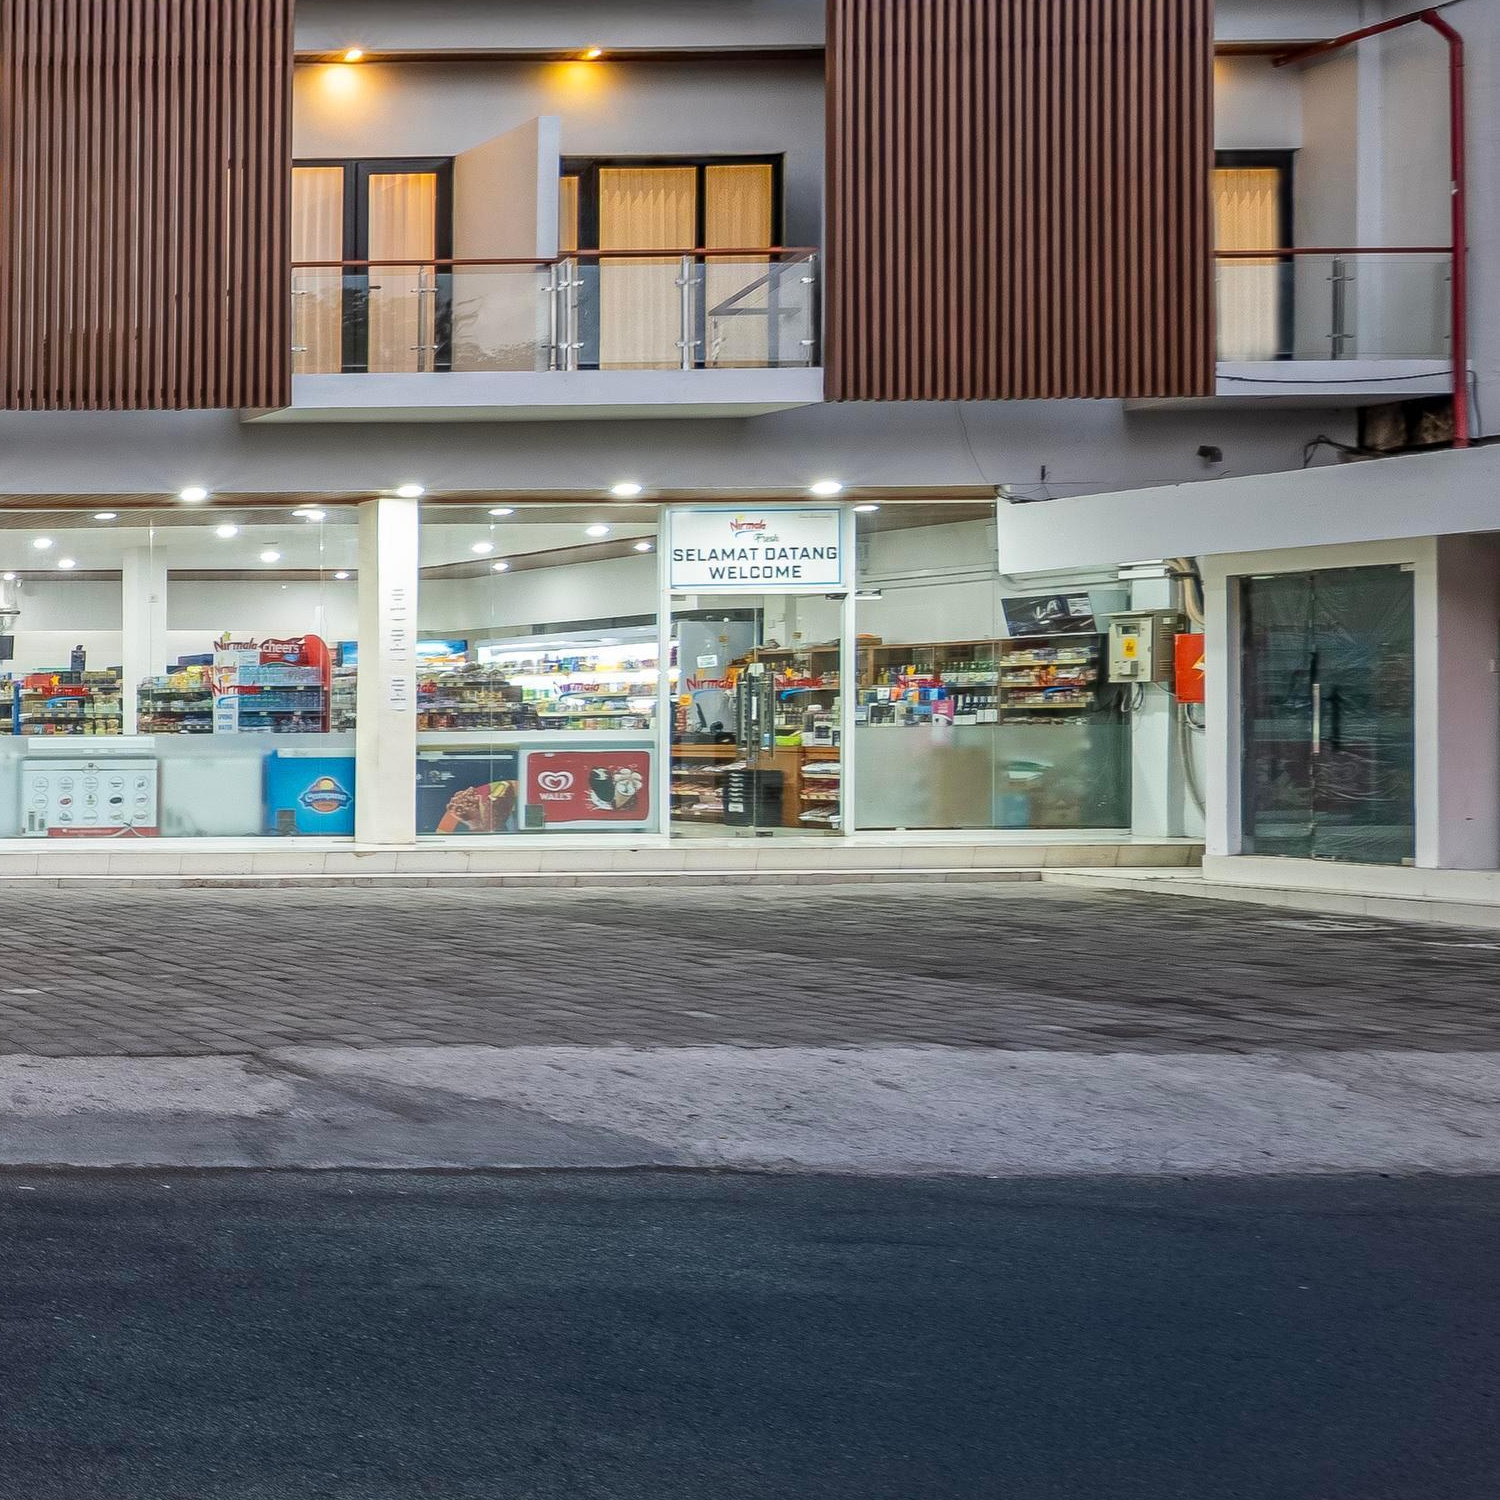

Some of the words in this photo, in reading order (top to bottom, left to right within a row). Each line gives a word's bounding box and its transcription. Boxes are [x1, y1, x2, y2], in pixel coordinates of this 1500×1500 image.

[754, 533, 780, 543] Fresh
[673, 548, 758, 562] SELAMAT
[765, 546, 837, 560] DATANG
[709, 565, 802, 579] WELCOME
[213, 637, 259, 652] Nirmala
[262, 642, 300, 653] cheers
